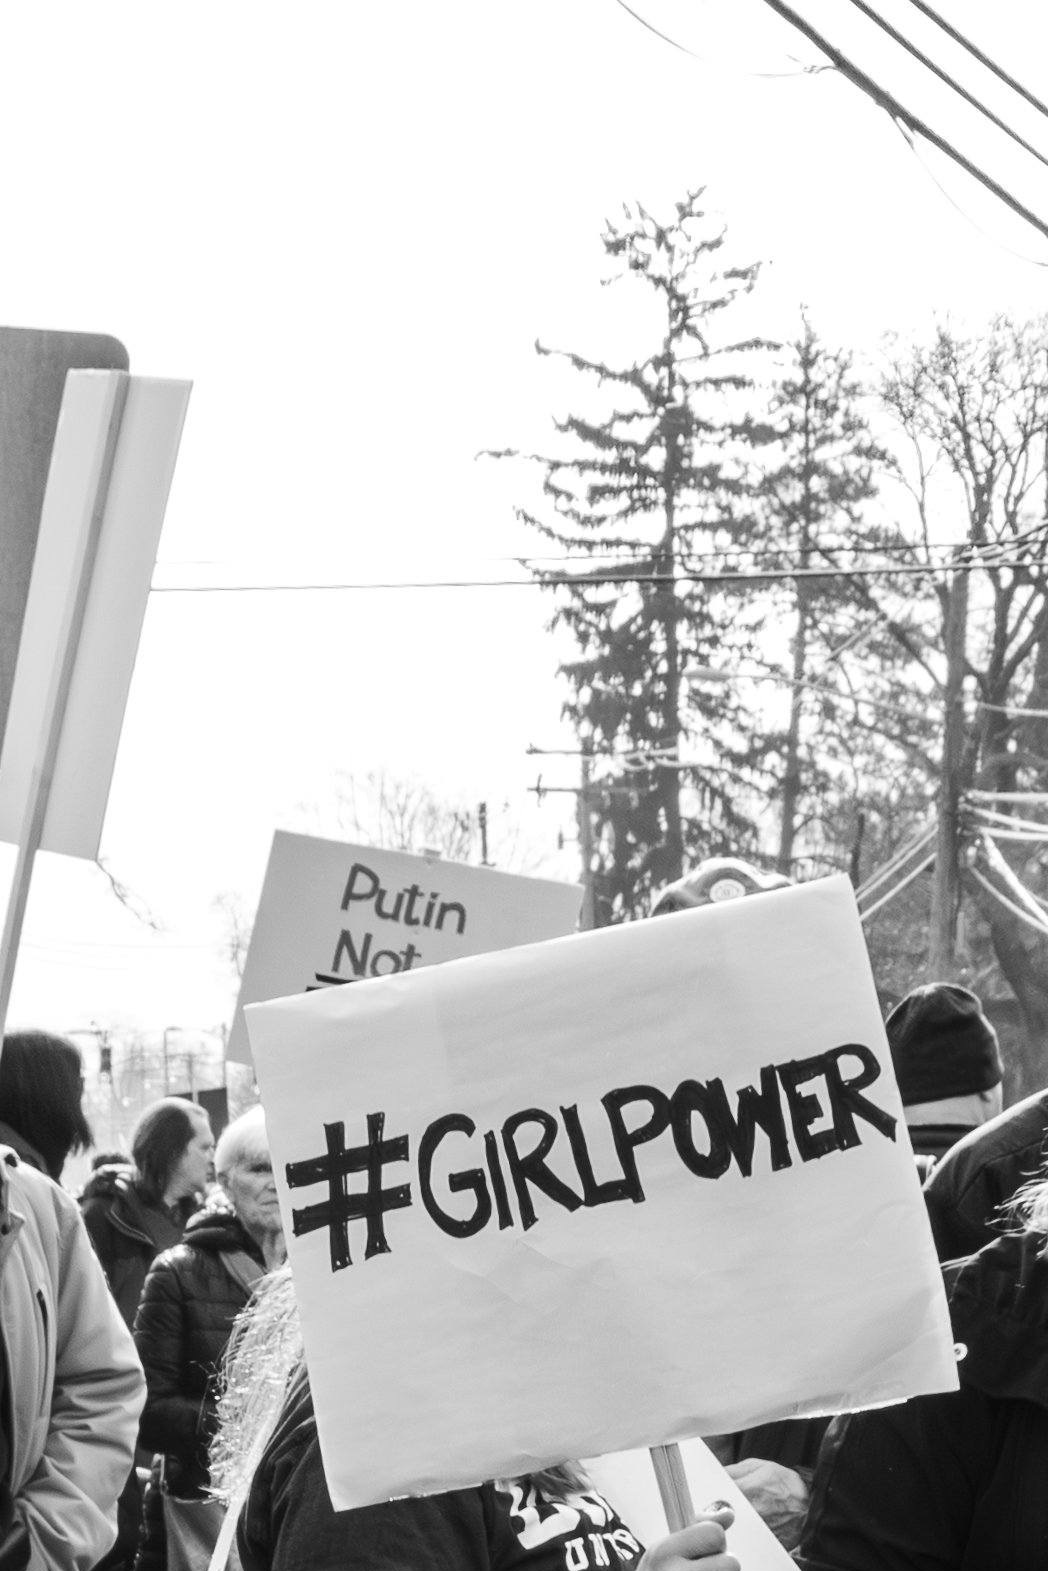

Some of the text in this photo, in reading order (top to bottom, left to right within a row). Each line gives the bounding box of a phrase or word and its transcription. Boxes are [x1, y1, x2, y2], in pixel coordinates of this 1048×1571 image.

[340, 862, 467, 936] Putin
[331, 928, 423, 978] Not
[286, 1043, 898, 1272] #GIRLPOWER
